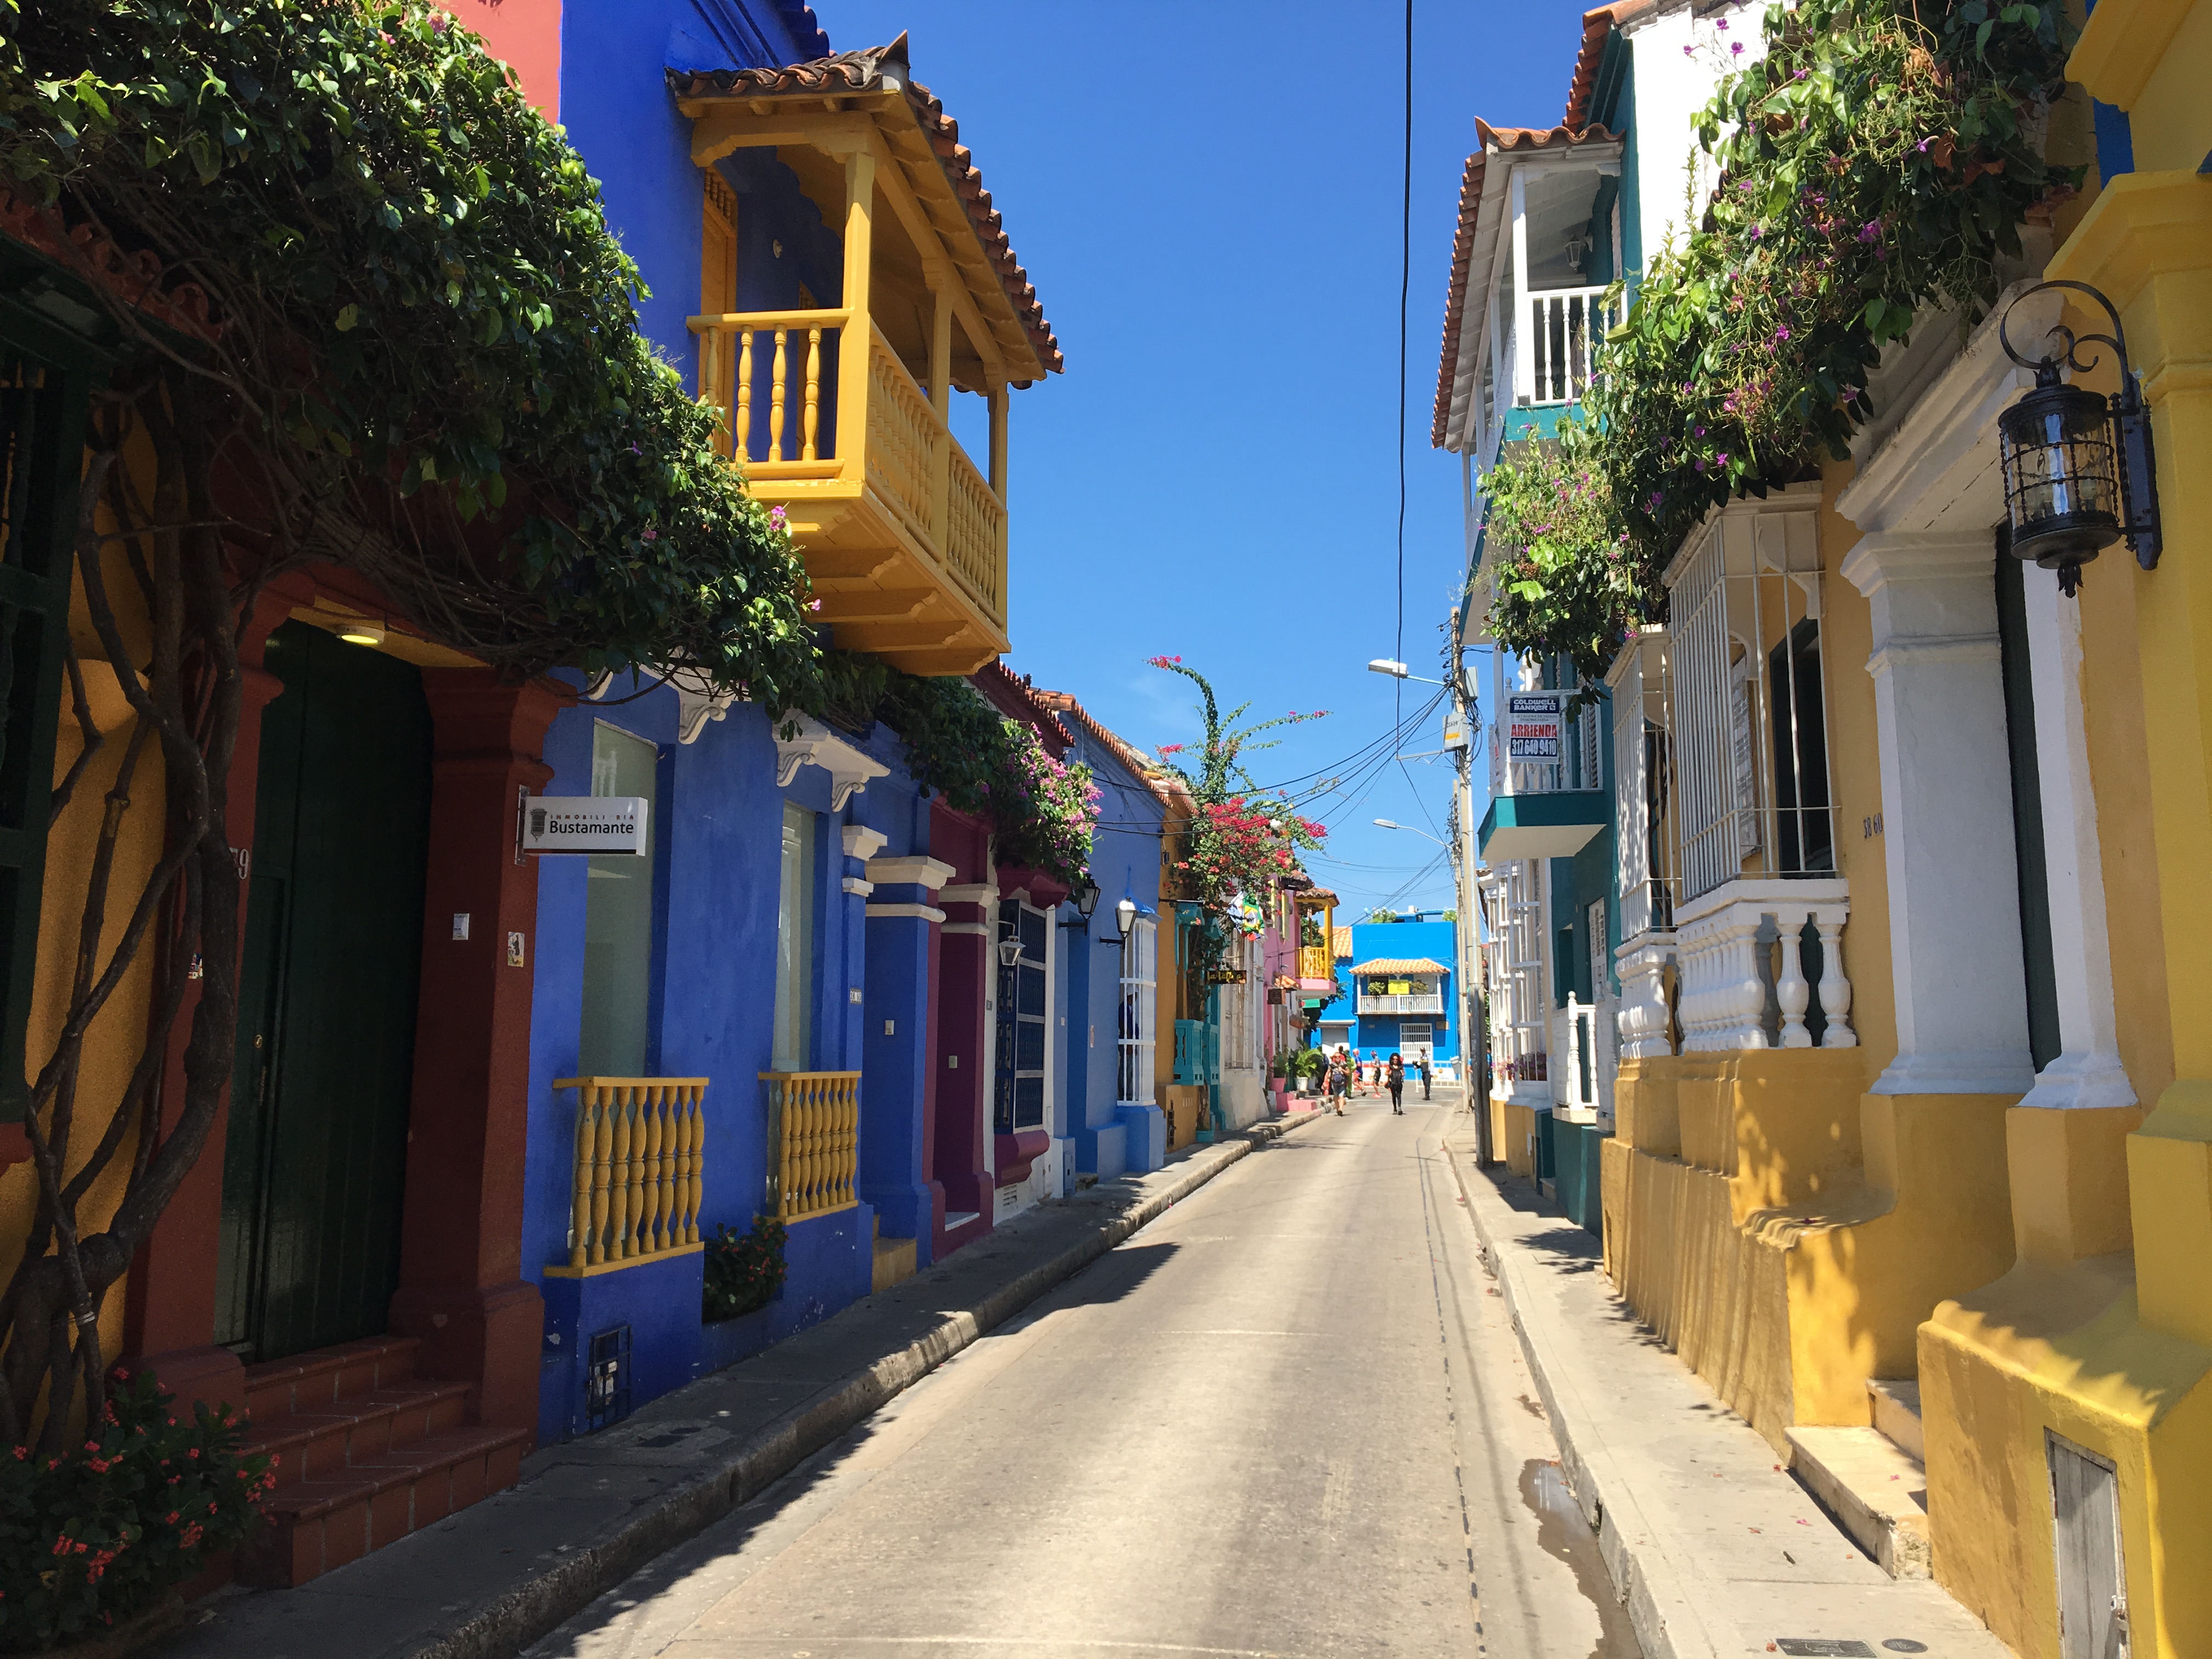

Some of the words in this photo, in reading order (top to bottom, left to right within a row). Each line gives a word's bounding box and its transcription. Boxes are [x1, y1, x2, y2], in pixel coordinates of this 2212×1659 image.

[1511, 724, 1558, 737] ARRIENDA
[1512, 739, 1524, 755] 317
[1525, 739, 1538, 755] 640
[1539, 739, 1556, 755] 9410
[550, 820, 634, 834] Bustamante
